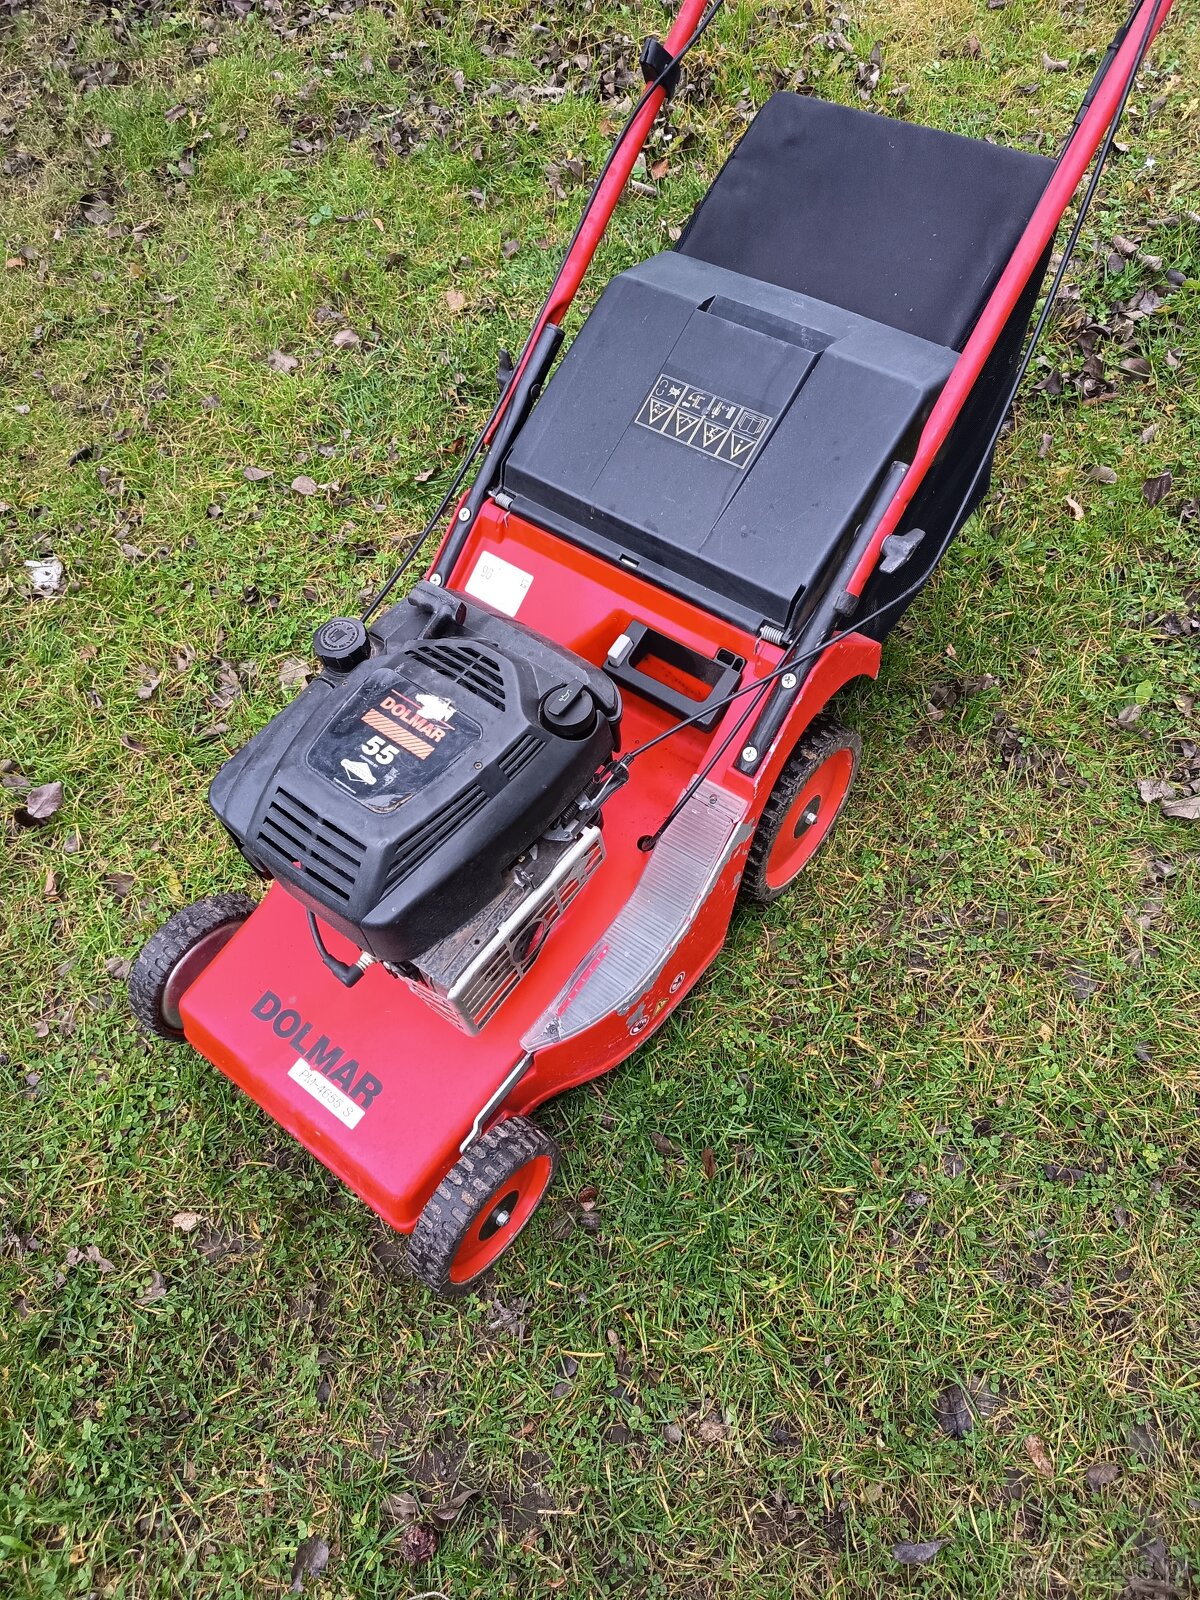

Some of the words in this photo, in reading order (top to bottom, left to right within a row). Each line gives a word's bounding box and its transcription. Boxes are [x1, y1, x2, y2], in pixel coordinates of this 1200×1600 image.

[380, 697, 446, 743] DOLMAR
[361, 736, 400, 765] 55
[250, 990, 384, 1110] DOLMAR
[298, 1069, 344, 1108] PM-4655
[343, 1106, 354, 1118] S
